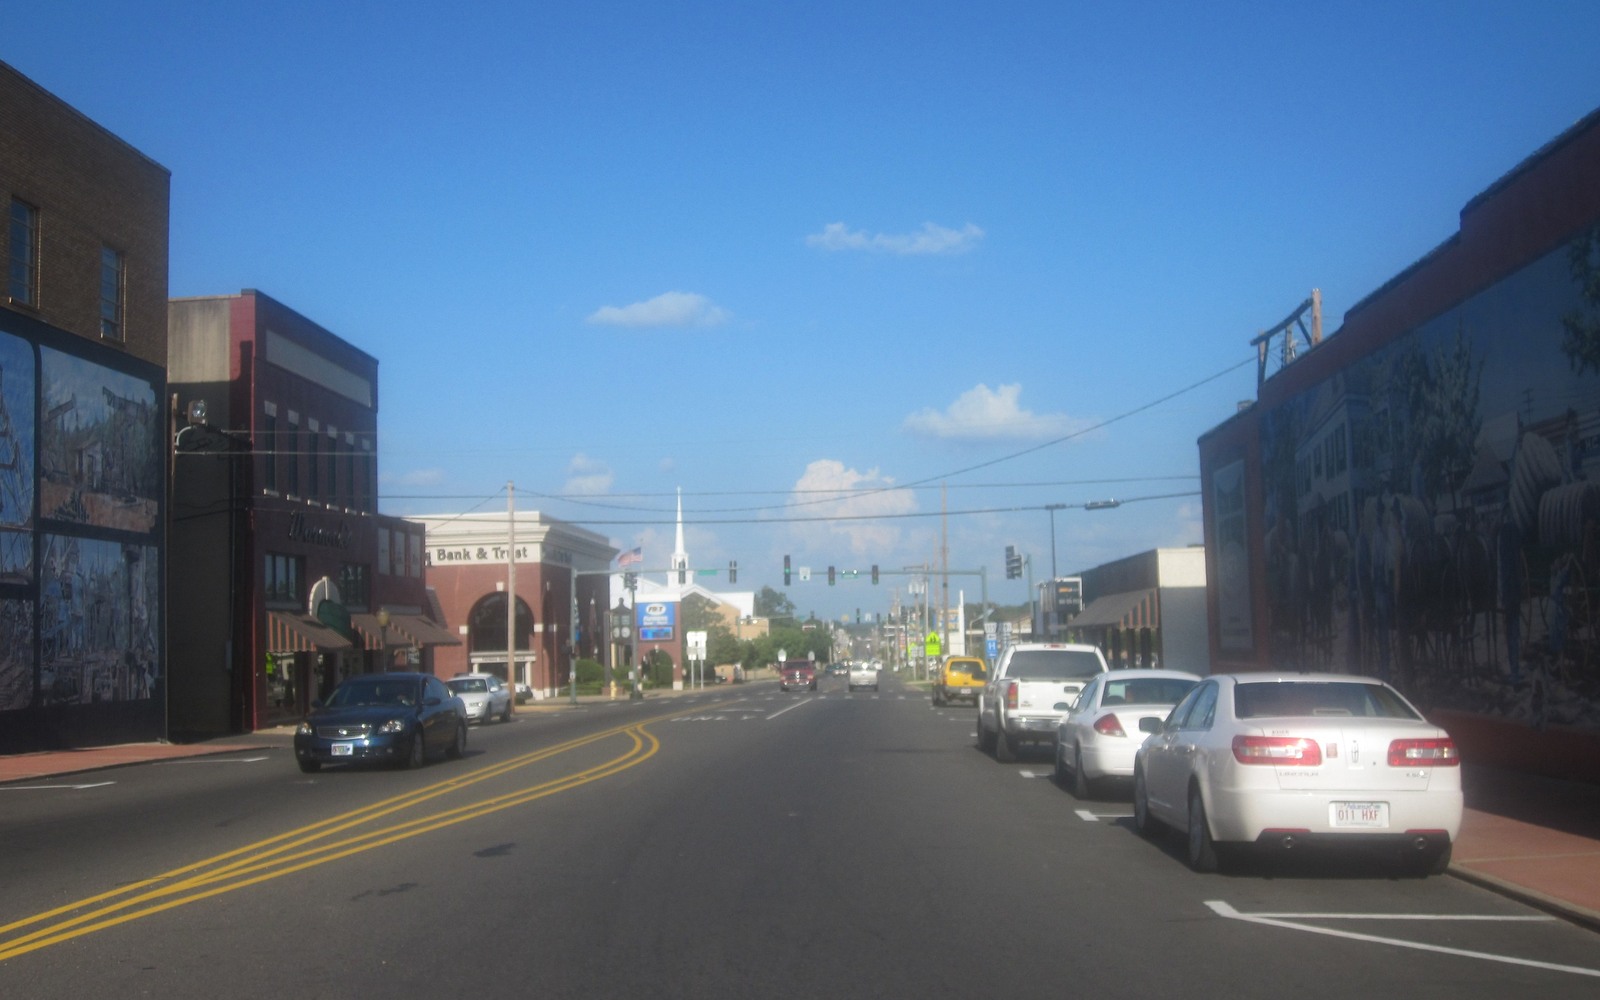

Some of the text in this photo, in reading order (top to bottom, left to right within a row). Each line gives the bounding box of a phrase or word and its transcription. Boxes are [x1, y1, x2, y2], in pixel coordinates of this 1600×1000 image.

[437, 548, 471, 560] Bank
[476, 547, 487, 560] &
[988, 642, 996, 651] H
